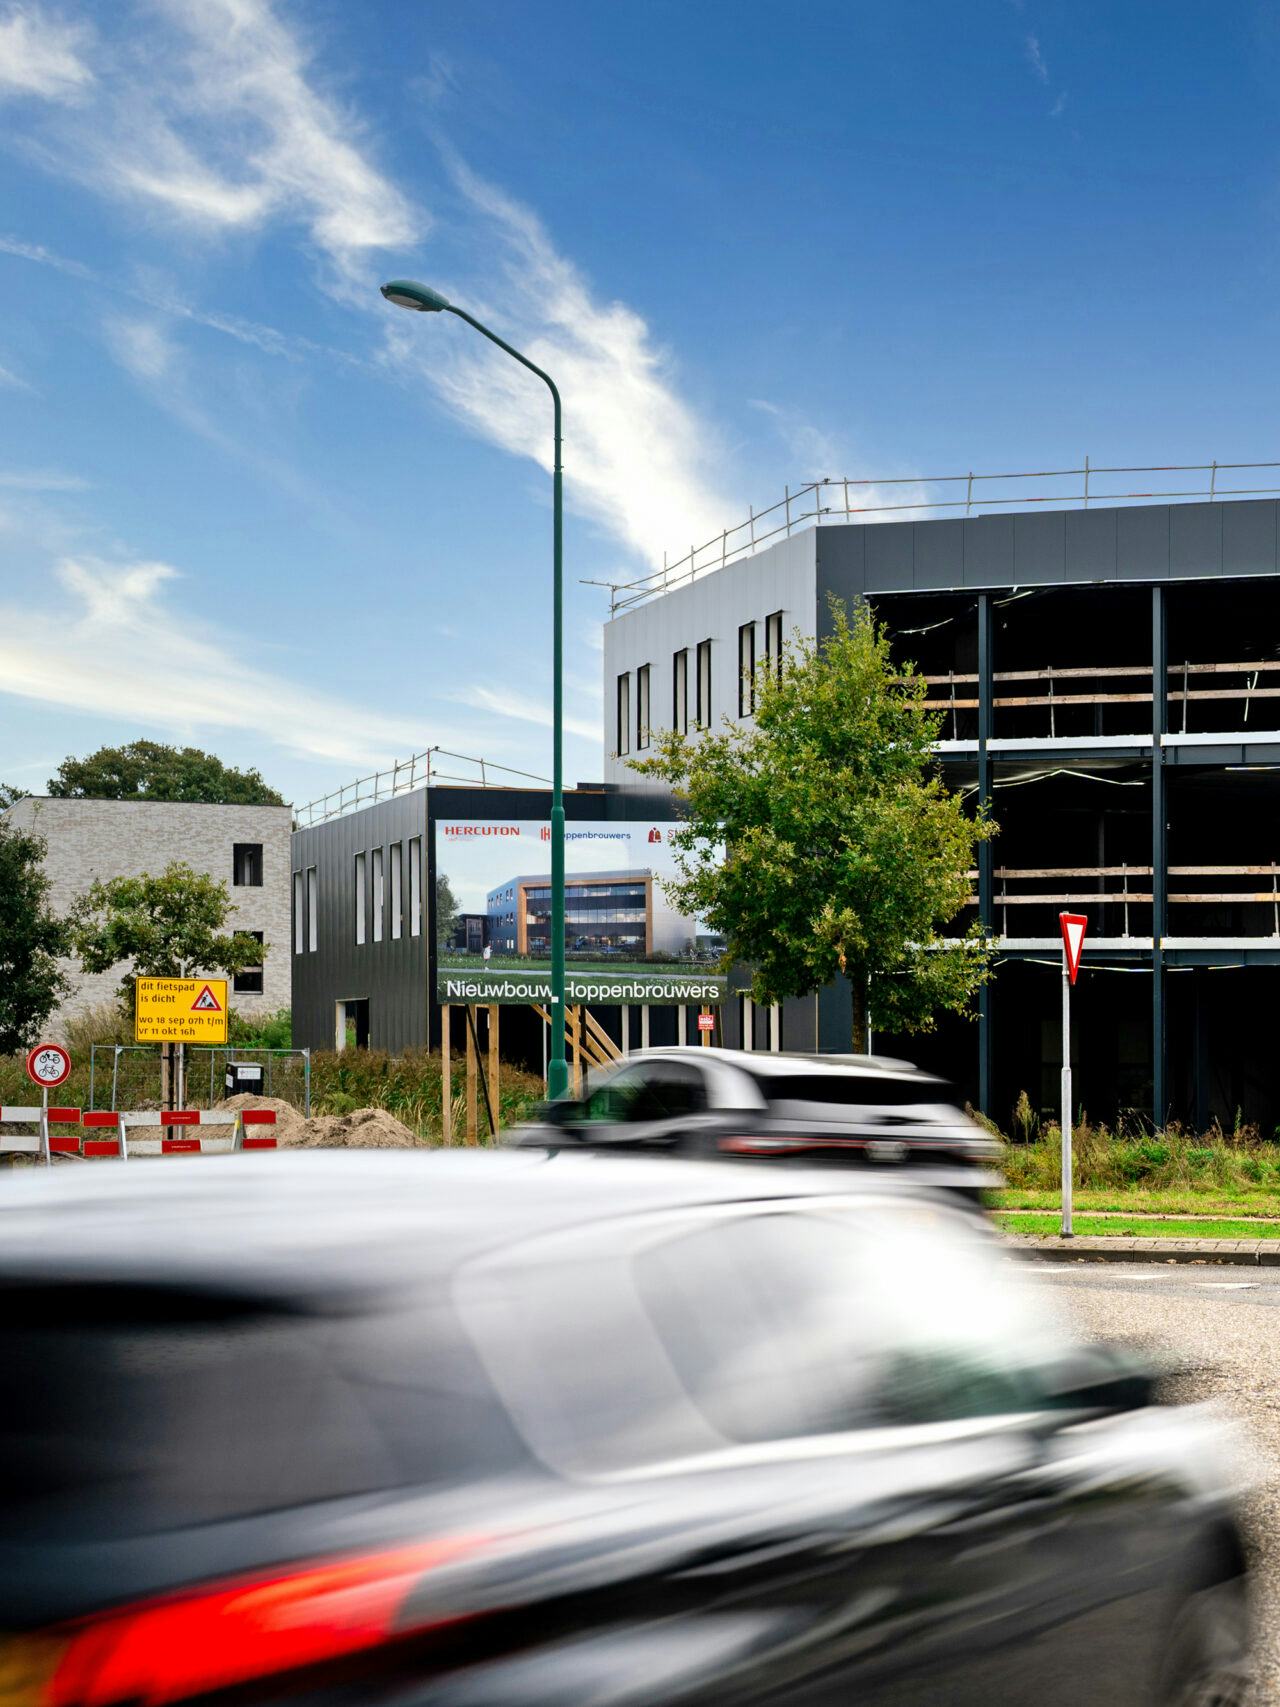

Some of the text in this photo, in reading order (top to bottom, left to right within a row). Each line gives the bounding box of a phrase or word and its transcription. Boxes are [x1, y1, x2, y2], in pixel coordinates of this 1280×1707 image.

[445, 826, 520, 835] HERCUTON
[564, 832, 631, 840] ppenbrouwers
[140, 982, 195, 992] dit fietspad
[564, 981, 719, 1001] Hoppenbrouwers
[140, 994, 176, 1003] is dicht
[168, 1017, 185, 1026] sep
[188, 1017, 204, 1025] 07h
[207, 1017, 224, 1027] t/m
[161, 1027, 177, 1035] okt
[180, 1028, 195, 1036] 16h
